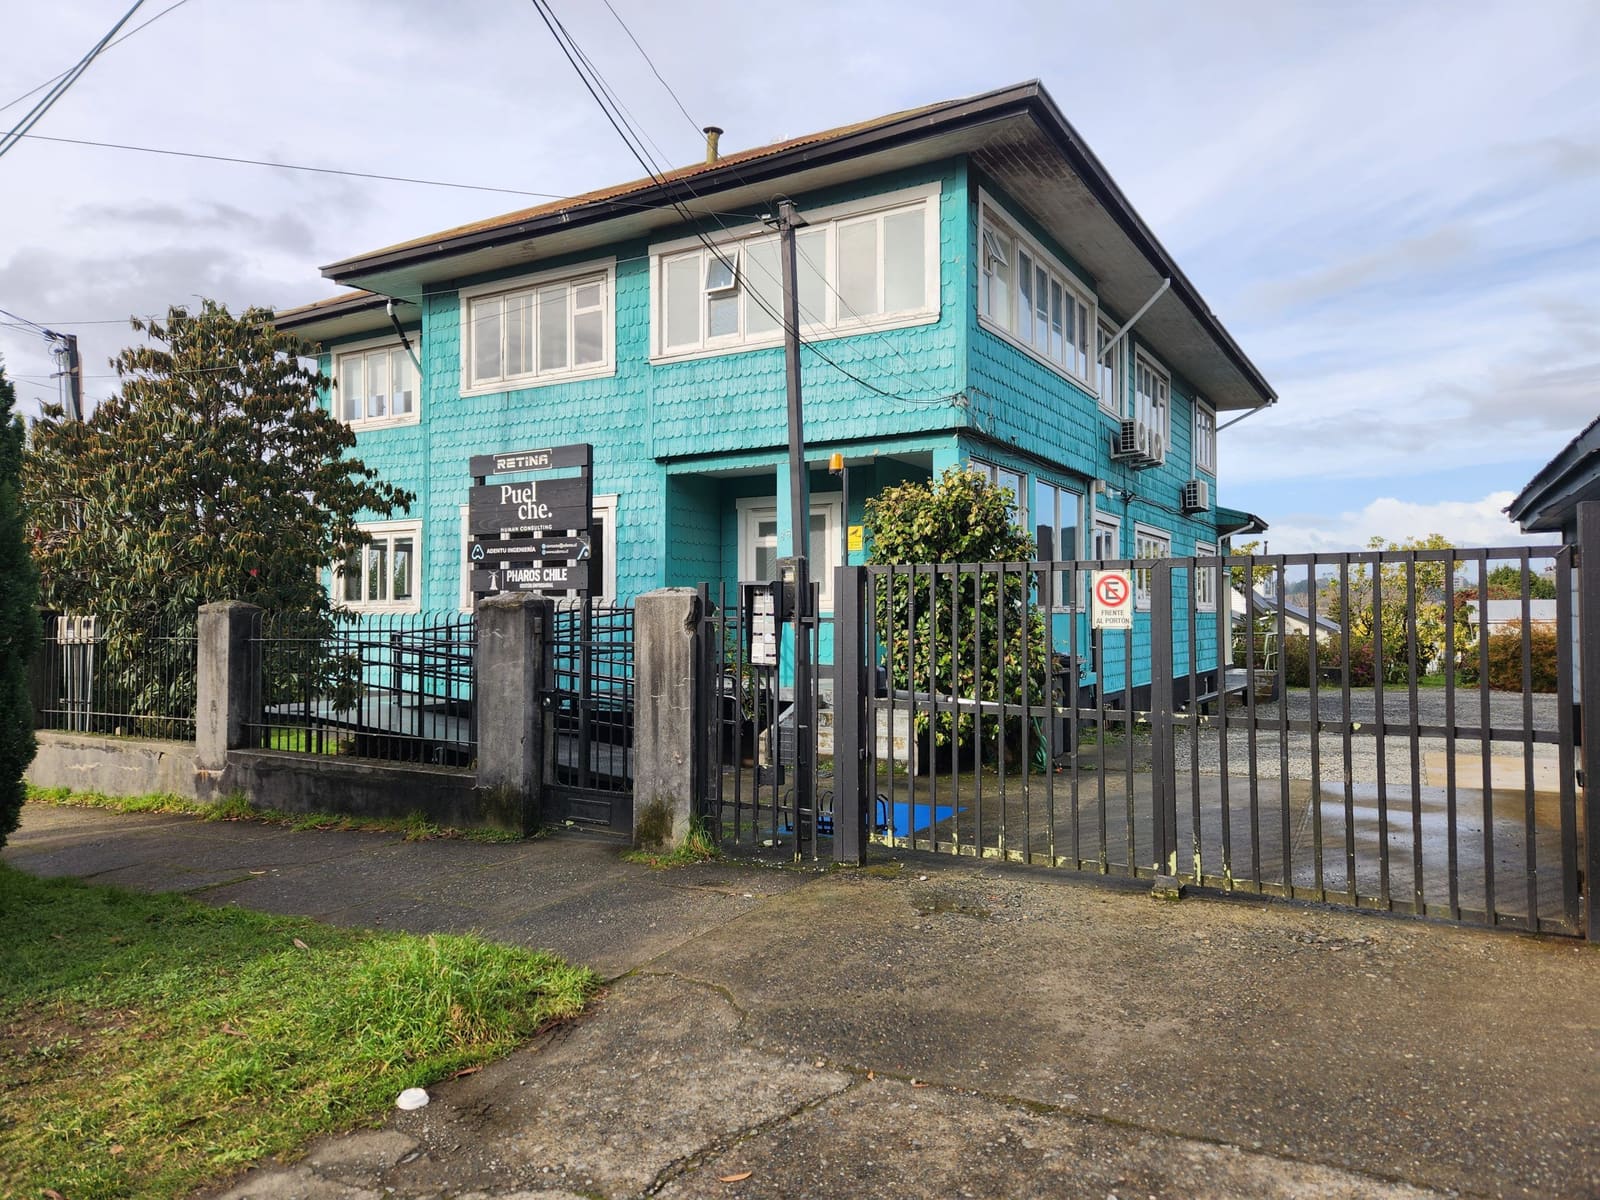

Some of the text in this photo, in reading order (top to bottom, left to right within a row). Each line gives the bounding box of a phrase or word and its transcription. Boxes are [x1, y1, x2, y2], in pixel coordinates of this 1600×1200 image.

[500, 481, 536, 505] Puel
[520, 524, 552, 532] CONSULTING
[507, 568, 568, 582] PHAROS CHILE
